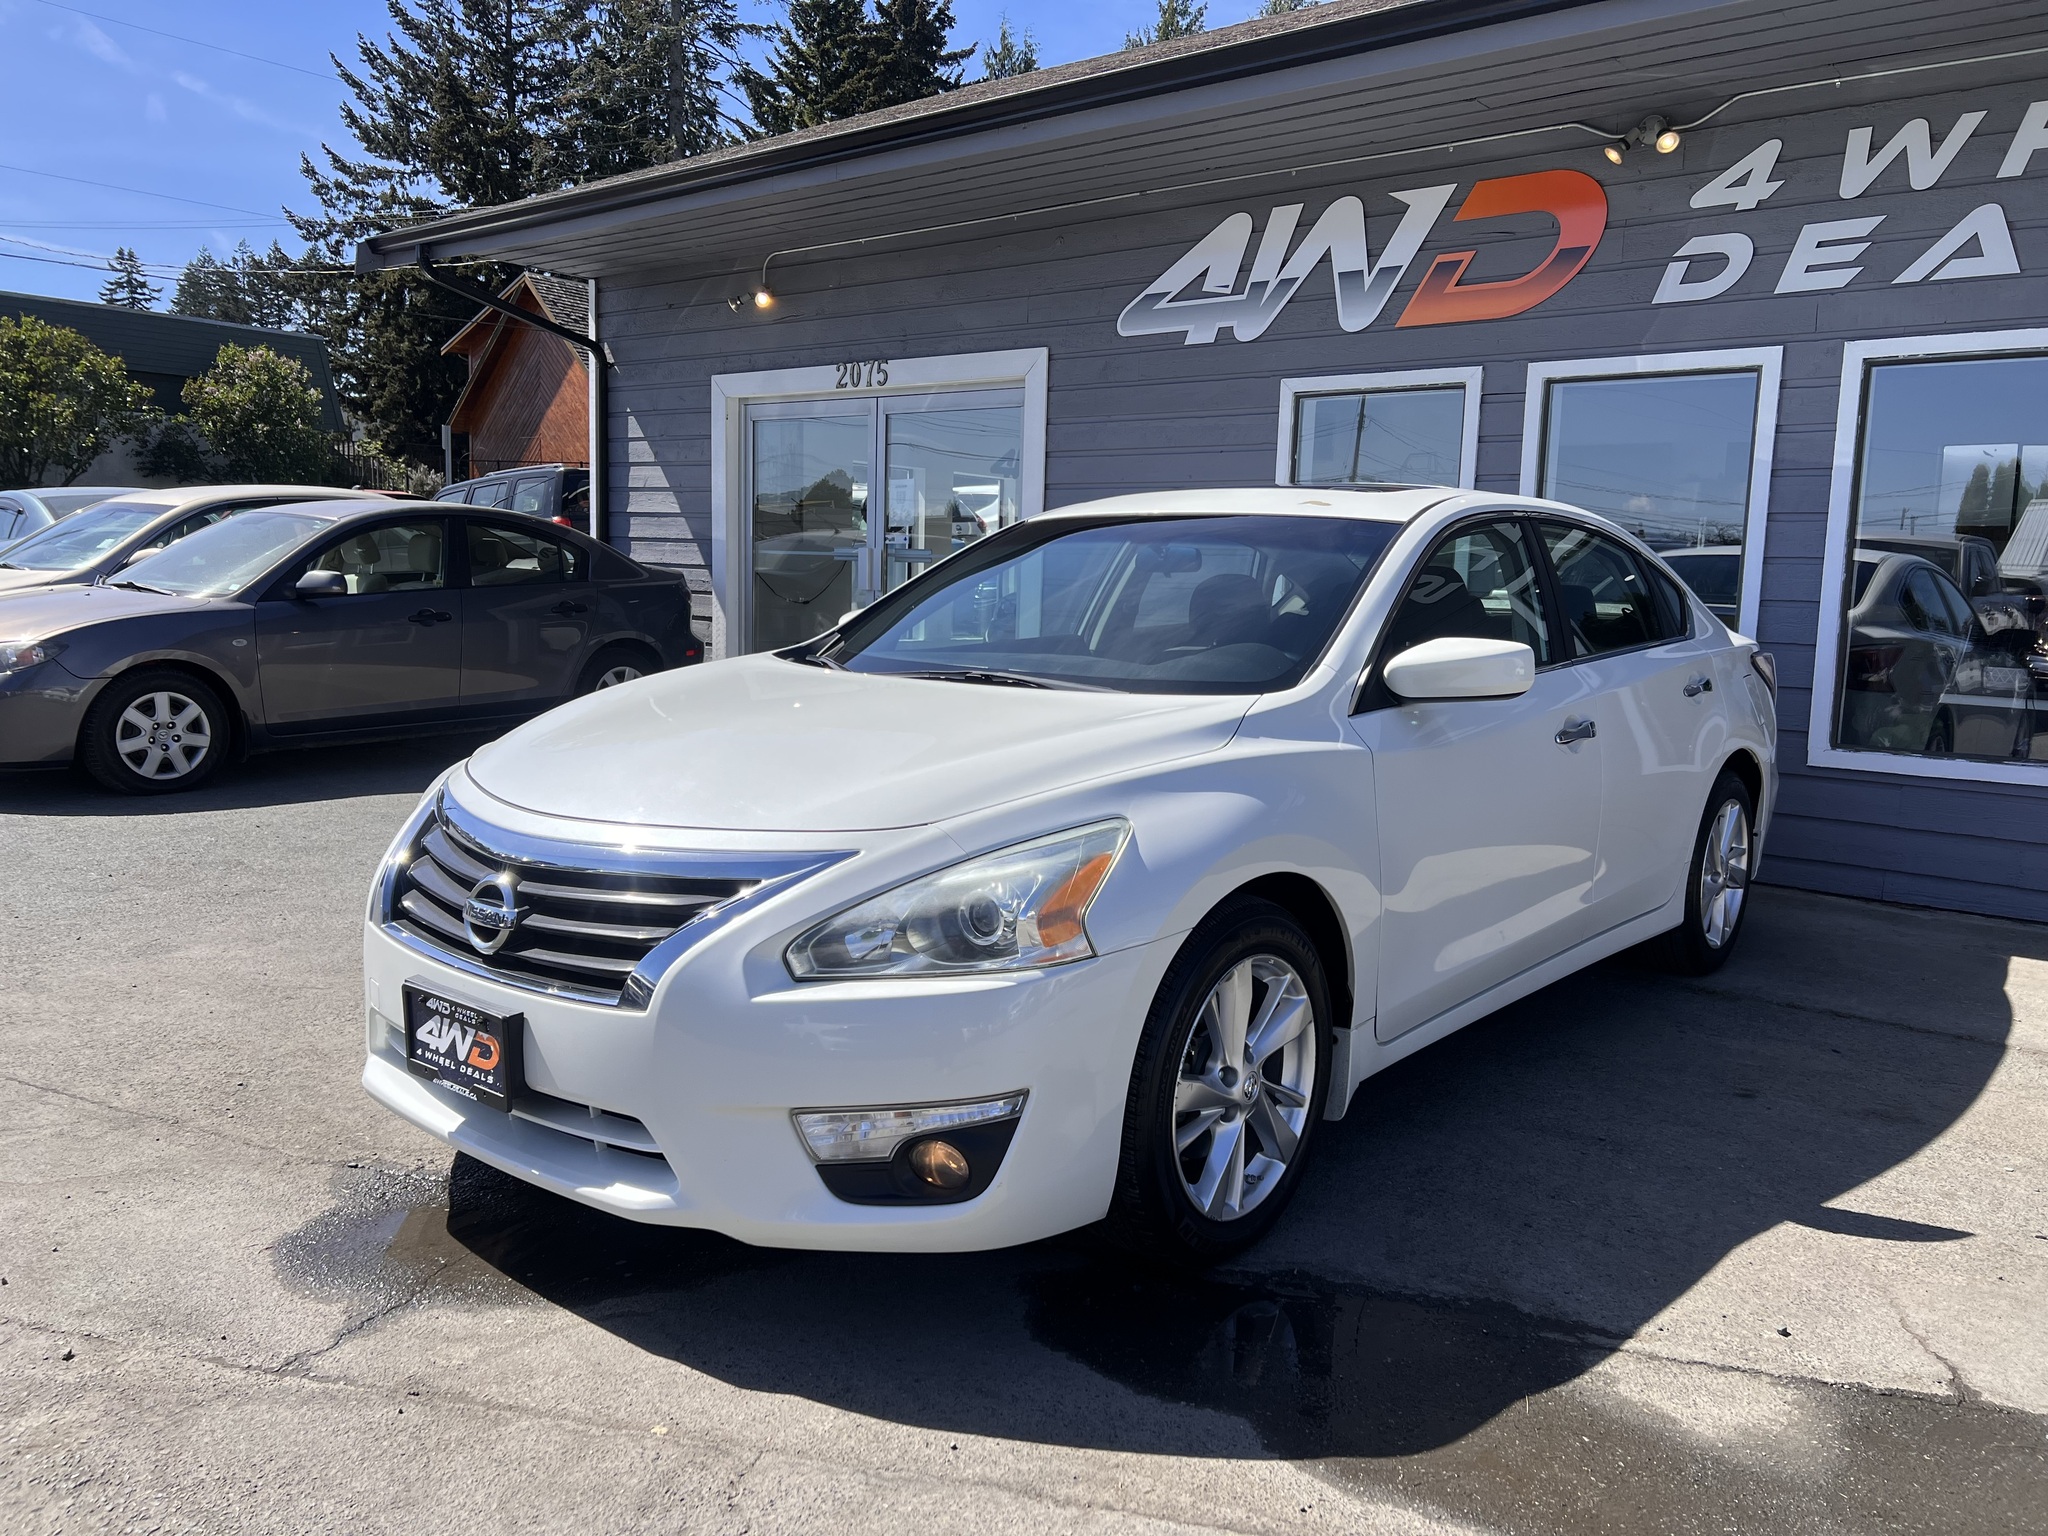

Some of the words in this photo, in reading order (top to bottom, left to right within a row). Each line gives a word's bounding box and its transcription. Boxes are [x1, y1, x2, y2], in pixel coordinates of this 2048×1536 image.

[1689, 138, 1786, 211] 4
[1116, 169, 1609, 346] 4WD
[1651, 203, 2021, 305] DEA
[835, 359, 889, 389] 2075
[415, 1014, 500, 1071] 4WD
[416, 1047, 423, 1056] 4
[424, 1050, 456, 1070] WHEEL
[459, 1064, 494, 1084] DEALS
